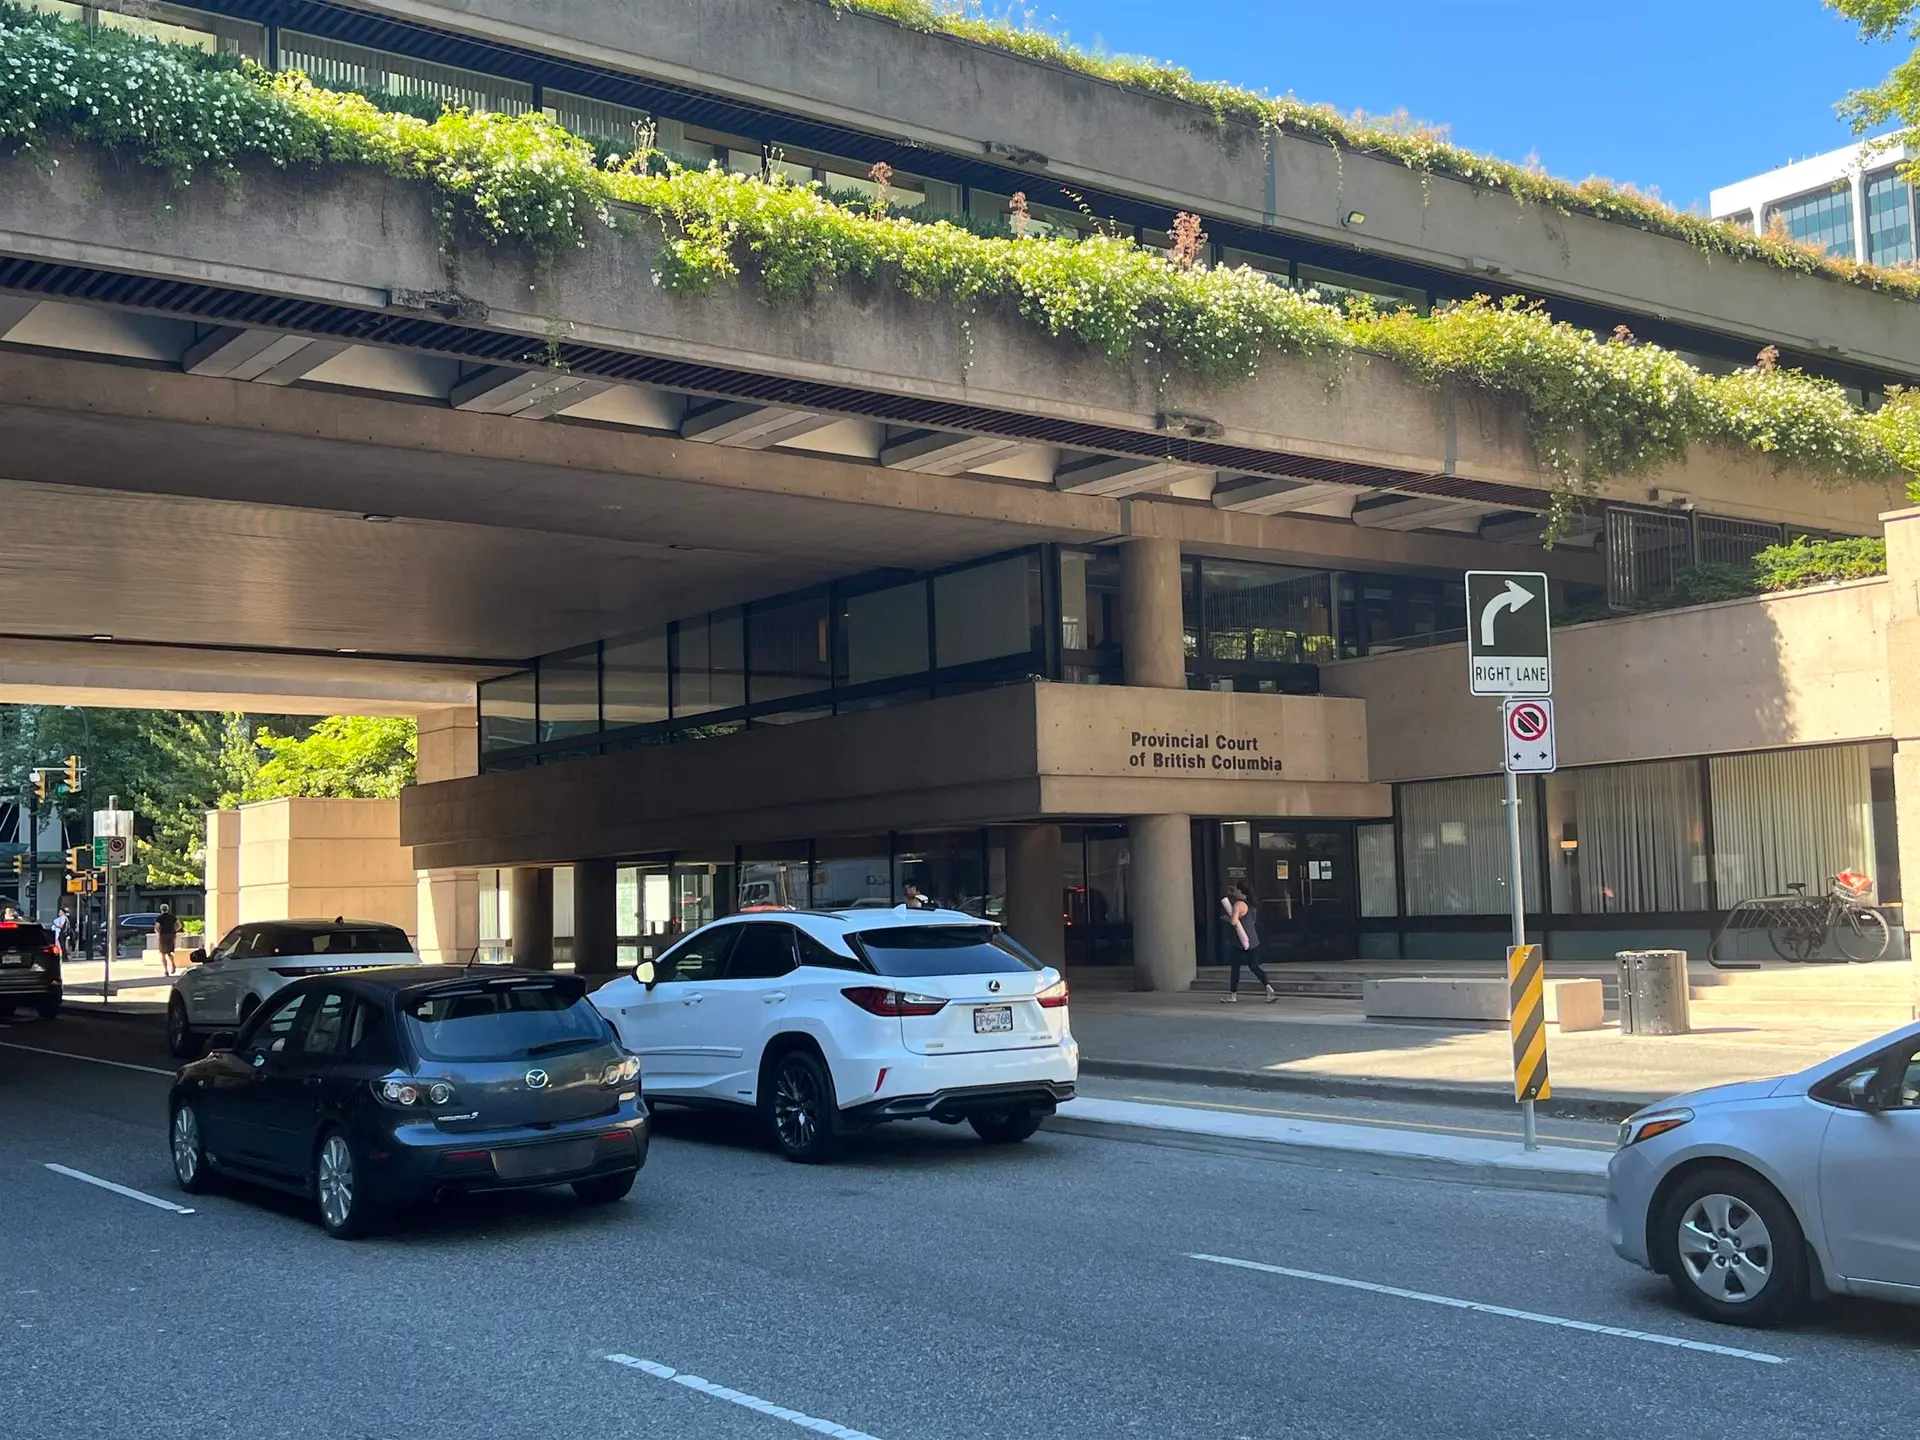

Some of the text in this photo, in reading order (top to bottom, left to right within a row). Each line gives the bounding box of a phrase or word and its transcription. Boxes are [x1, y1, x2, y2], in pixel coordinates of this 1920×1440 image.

[1475, 666, 1546, 682] RIGHT LANE
[1131, 731, 1259, 751] Provincial Court
[1129, 752, 1283, 771] of British Columbia
